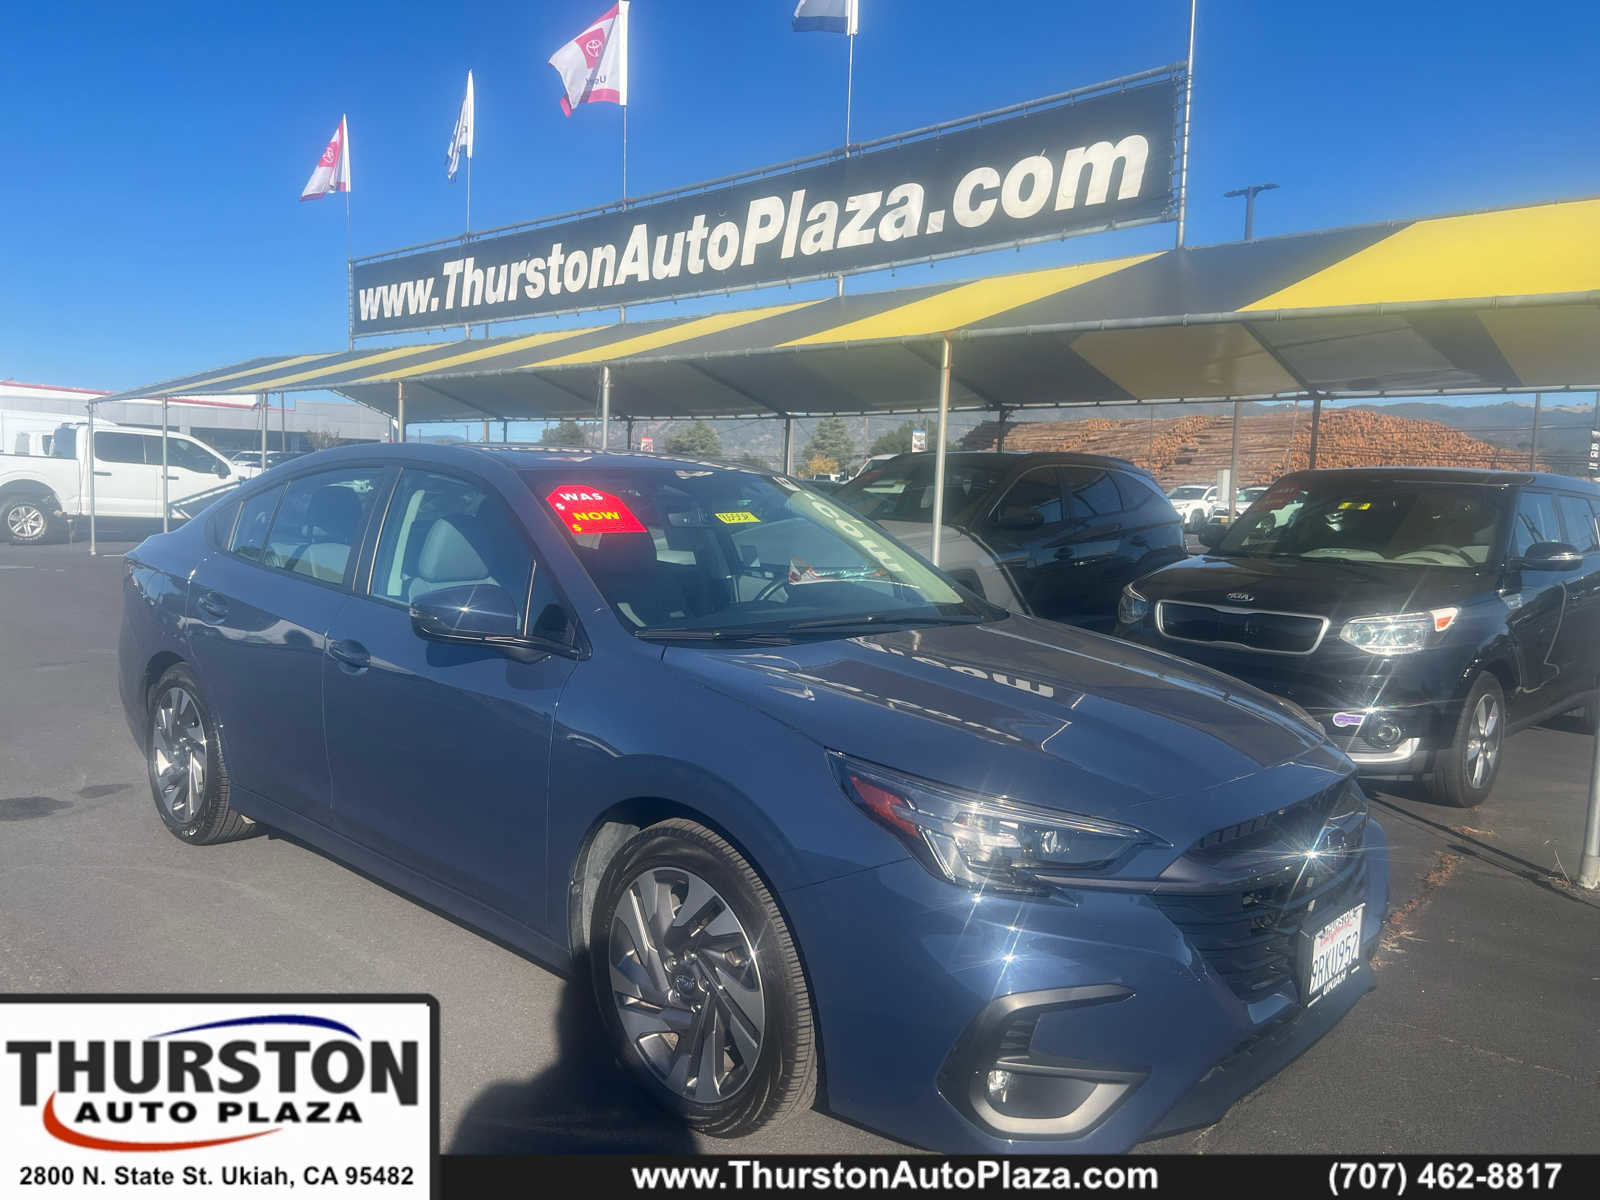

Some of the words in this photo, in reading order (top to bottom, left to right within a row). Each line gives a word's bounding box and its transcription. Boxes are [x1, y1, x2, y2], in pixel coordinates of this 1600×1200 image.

[358, 134, 1150, 320] www.ThurstonAutoPlaza.com
[573, 512, 620, 520] NOW
[1310, 931, 1359, 991] 9RKU952
